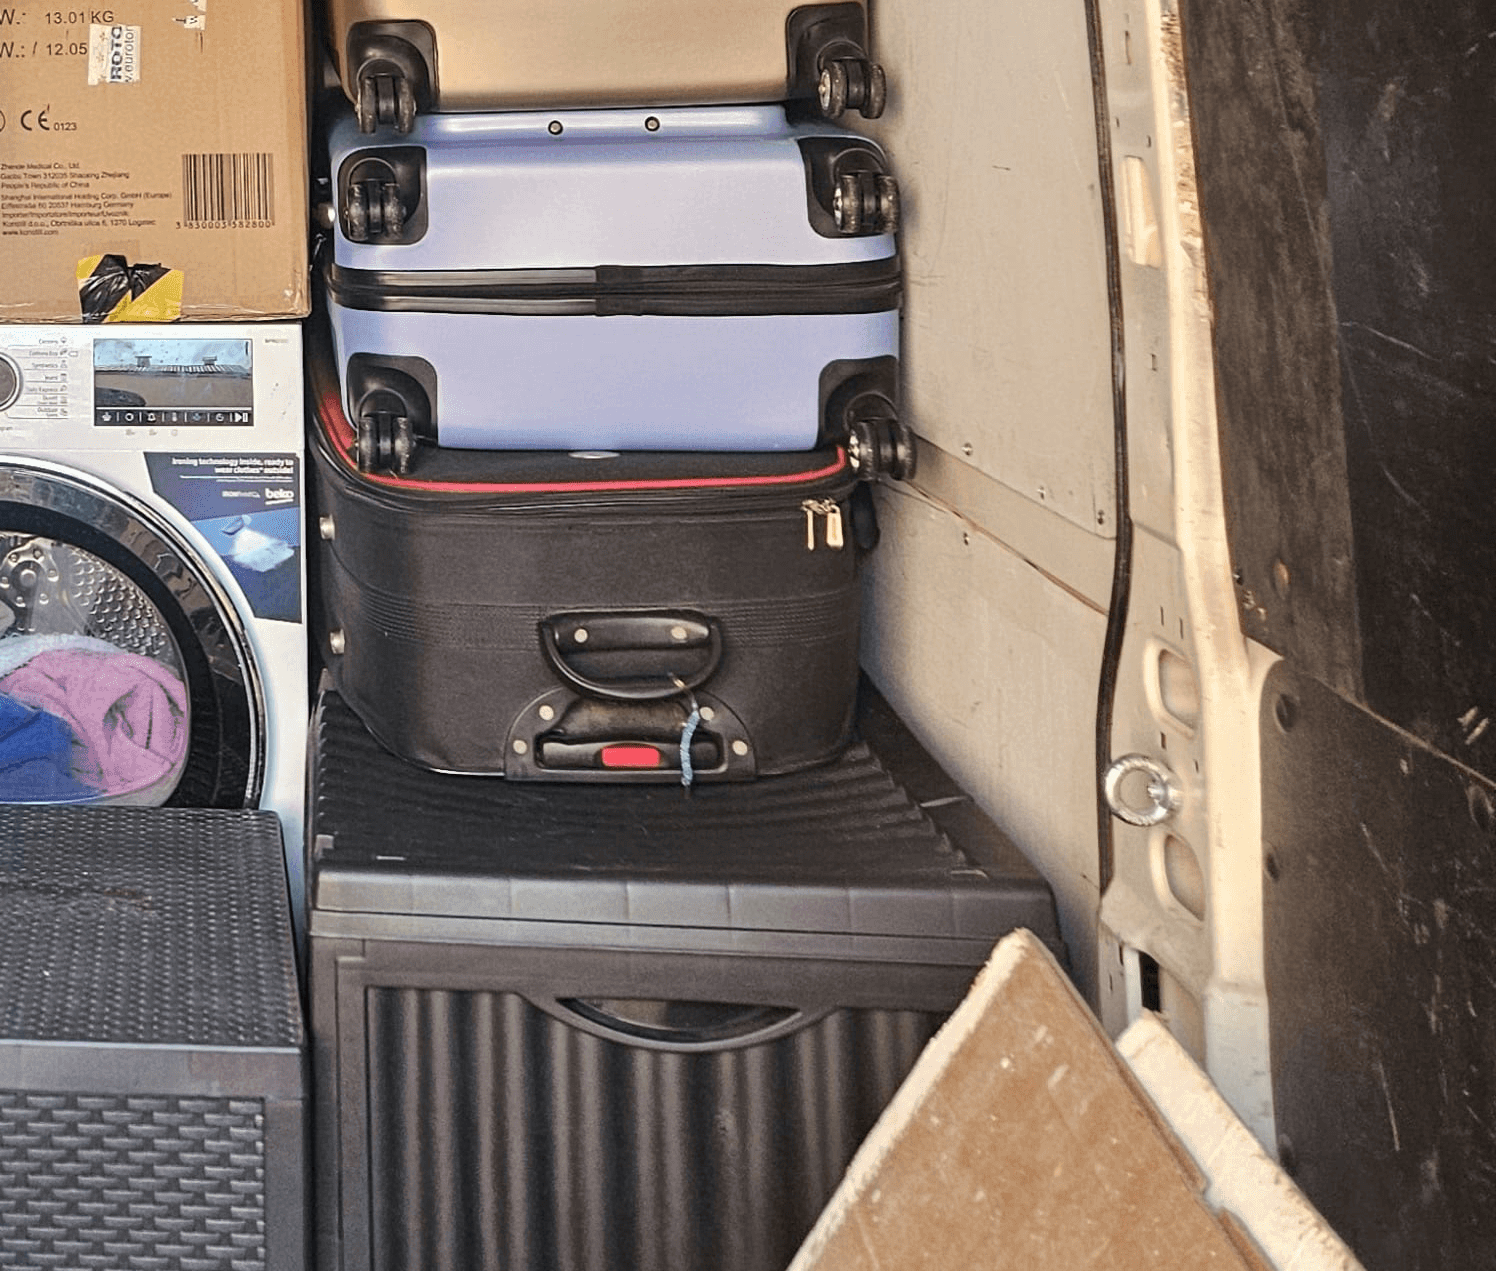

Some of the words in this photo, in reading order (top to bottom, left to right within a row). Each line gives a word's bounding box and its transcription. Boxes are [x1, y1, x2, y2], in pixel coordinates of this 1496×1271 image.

[44, 11, 86, 25] 13.01
[90, 10, 115, 24] KG
[45, 42, 88, 56] 12.05
[53, 121, 78, 132] 0123
[264, 487, 295, 499] beko
